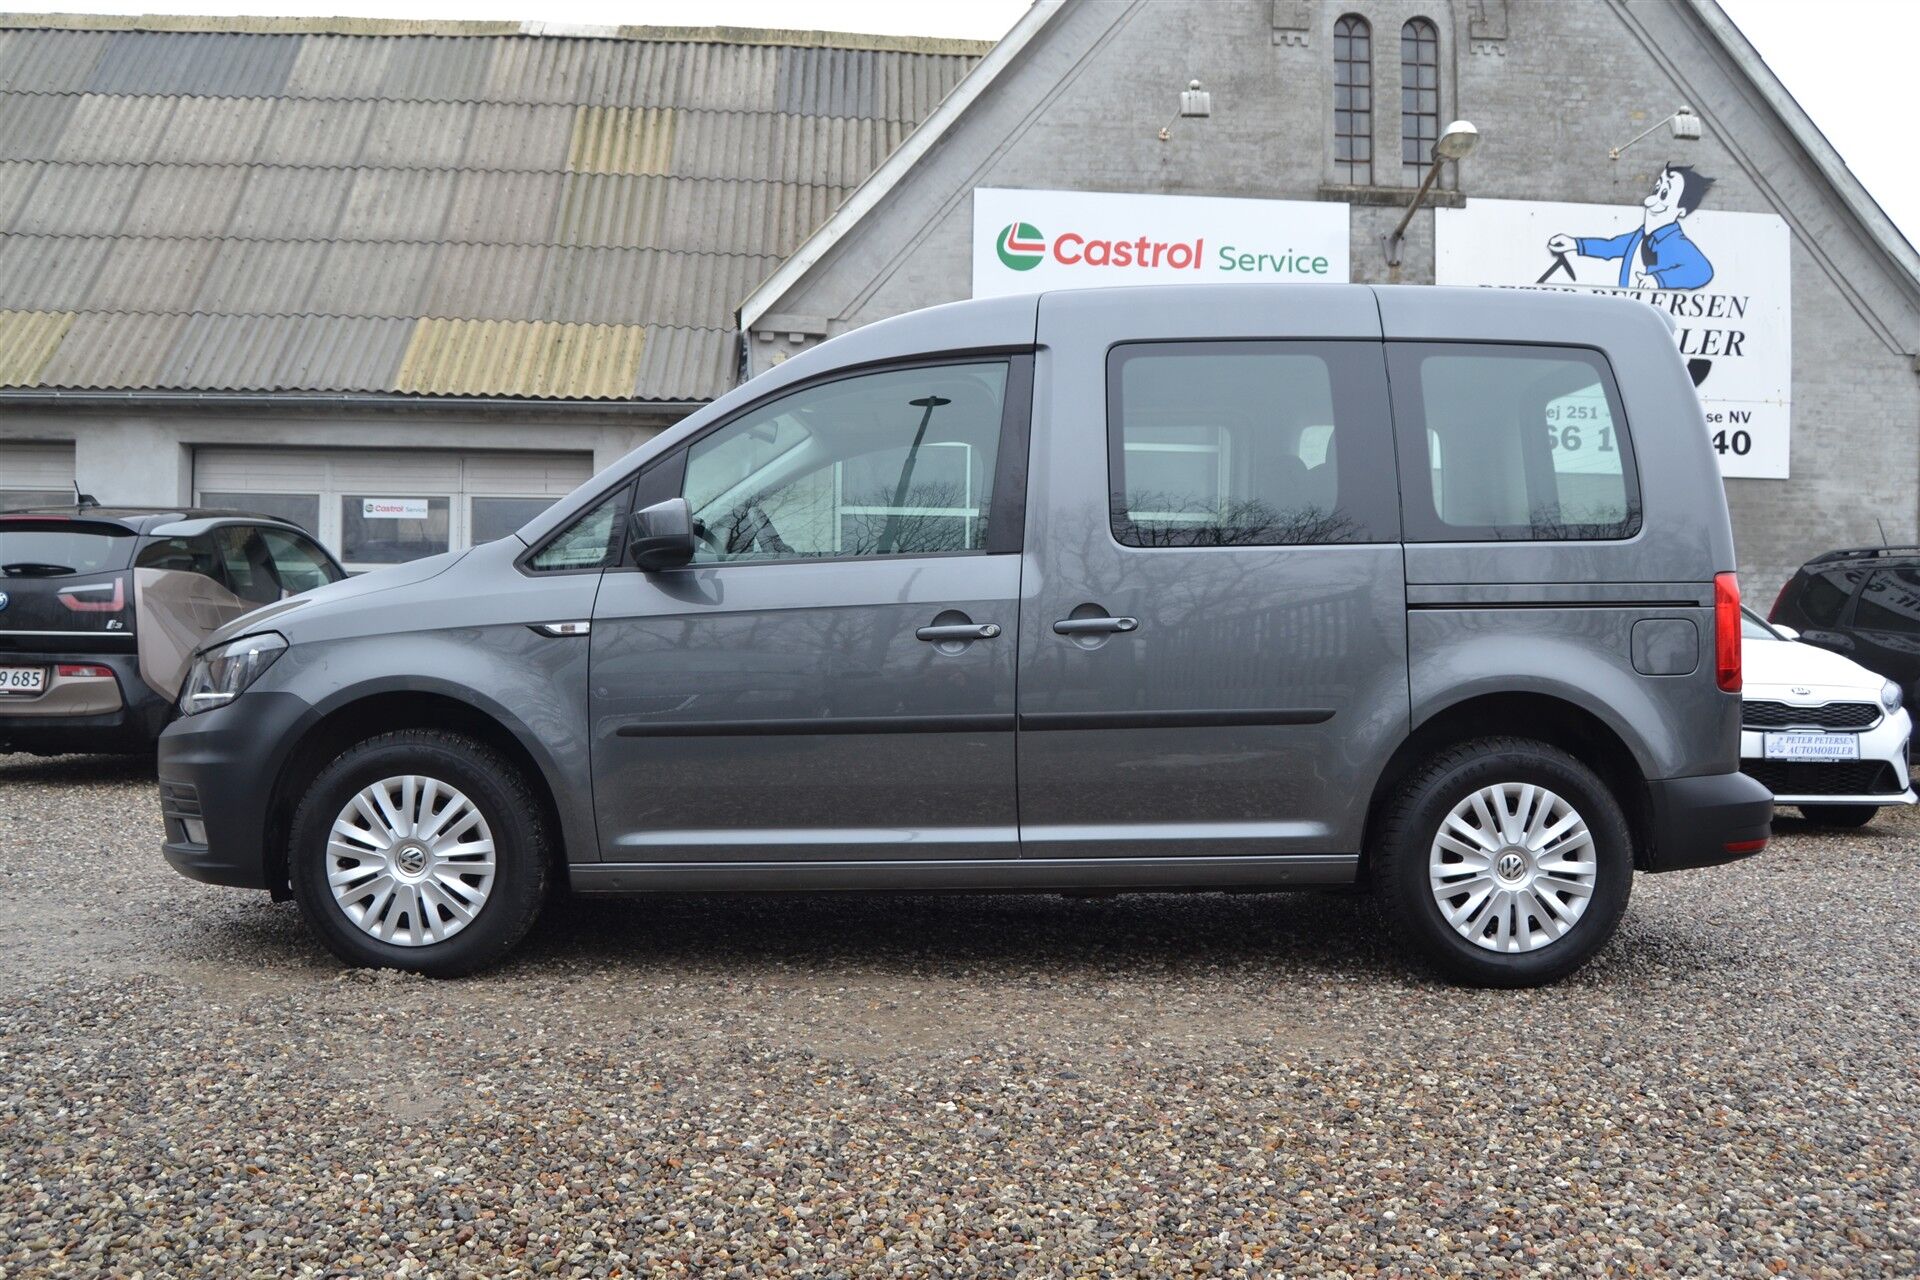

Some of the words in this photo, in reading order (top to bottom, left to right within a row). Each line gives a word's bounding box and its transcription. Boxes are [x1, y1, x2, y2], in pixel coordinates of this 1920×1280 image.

[1053, 232, 1204, 270] Castrol
[1218, 246, 1329, 275] Service
[1592, 289, 1750, 319] ERSEN
[1674, 328, 1746, 357] LER
[1566, 405, 1598, 420] 251
[1729, 410, 1752, 424] NV
[1712, 429, 1752, 456] 40
[374, 504, 404, 513] Castrol
[405, 505, 427, 513] Service
[11, 671, 40, 687] 685
[1786, 736, 1813, 745] PETER
[1814, 736, 1855, 745] PETERSEN
[1788, 745, 1854, 755] AUTOMOBILER
